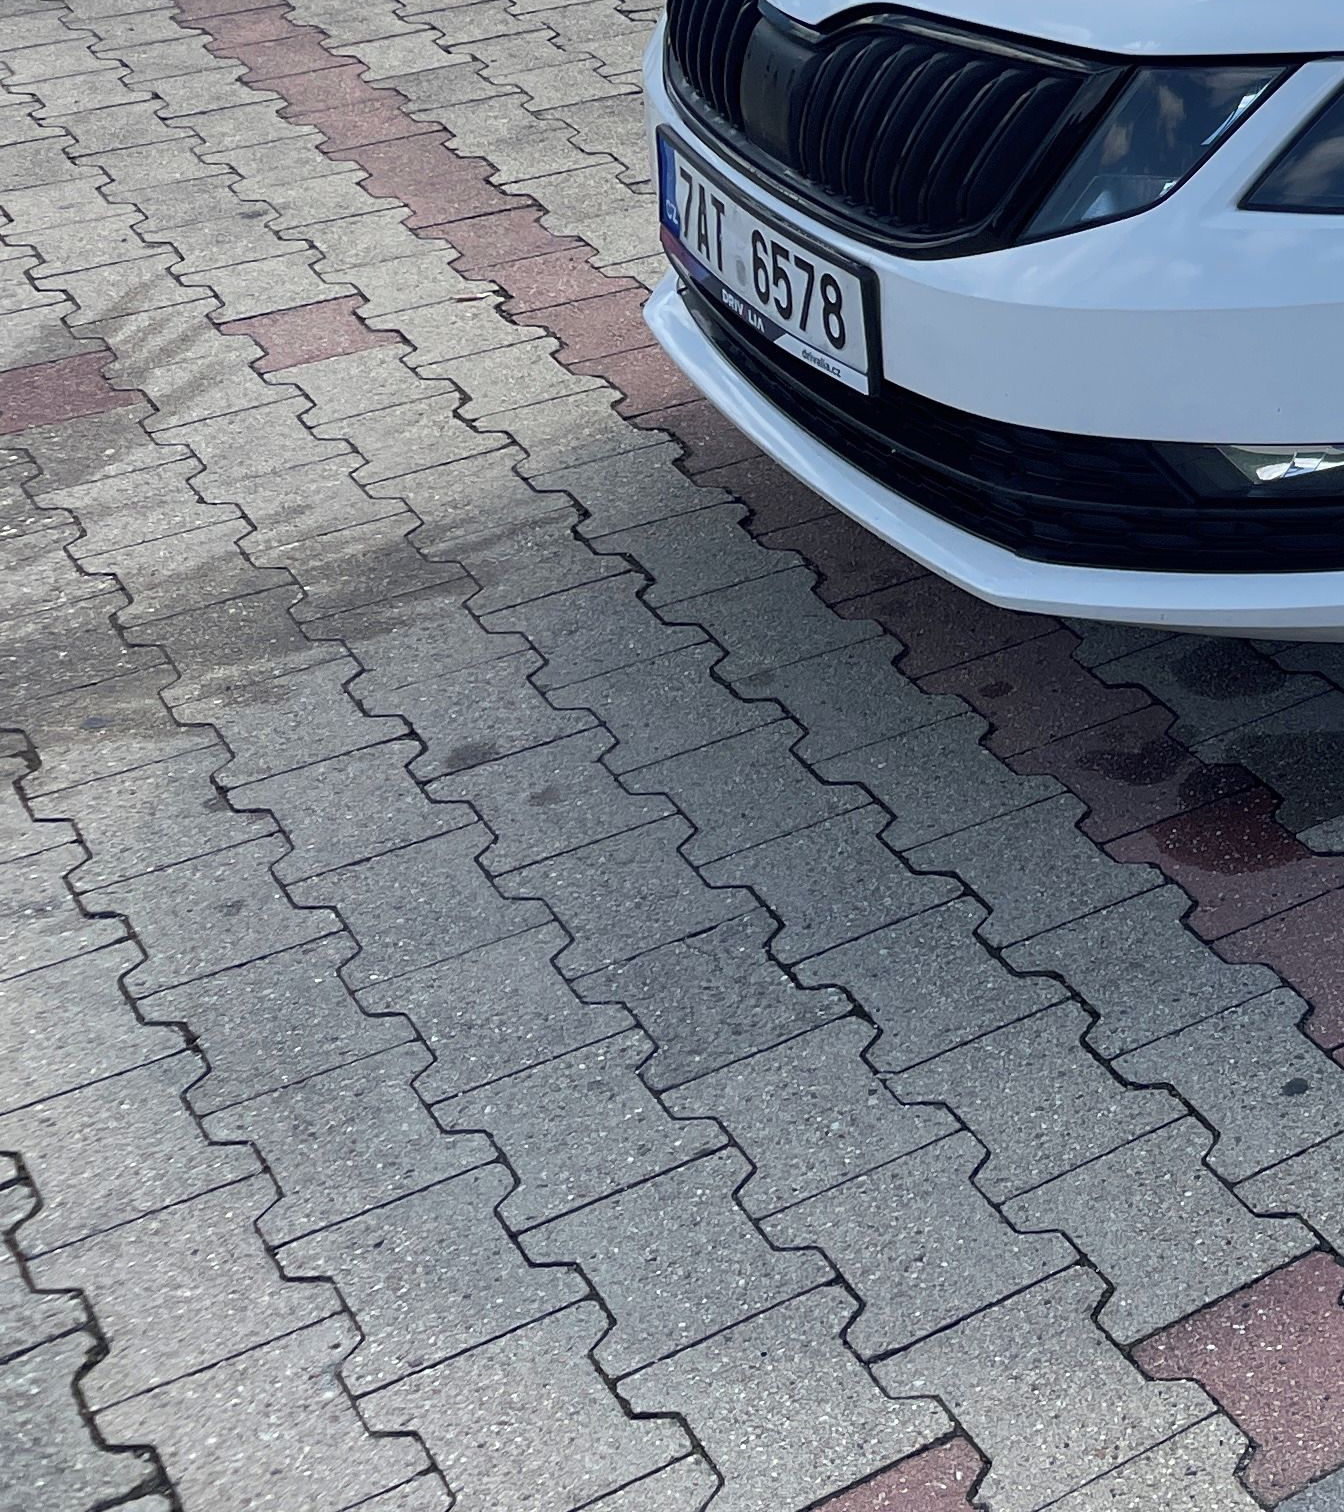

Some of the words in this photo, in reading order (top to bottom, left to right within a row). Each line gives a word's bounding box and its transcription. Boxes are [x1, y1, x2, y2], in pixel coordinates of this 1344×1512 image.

[665, 199, 679, 225] CZ
[676, 166, 726, 273] 7AT
[751, 229, 846, 350] 6578
